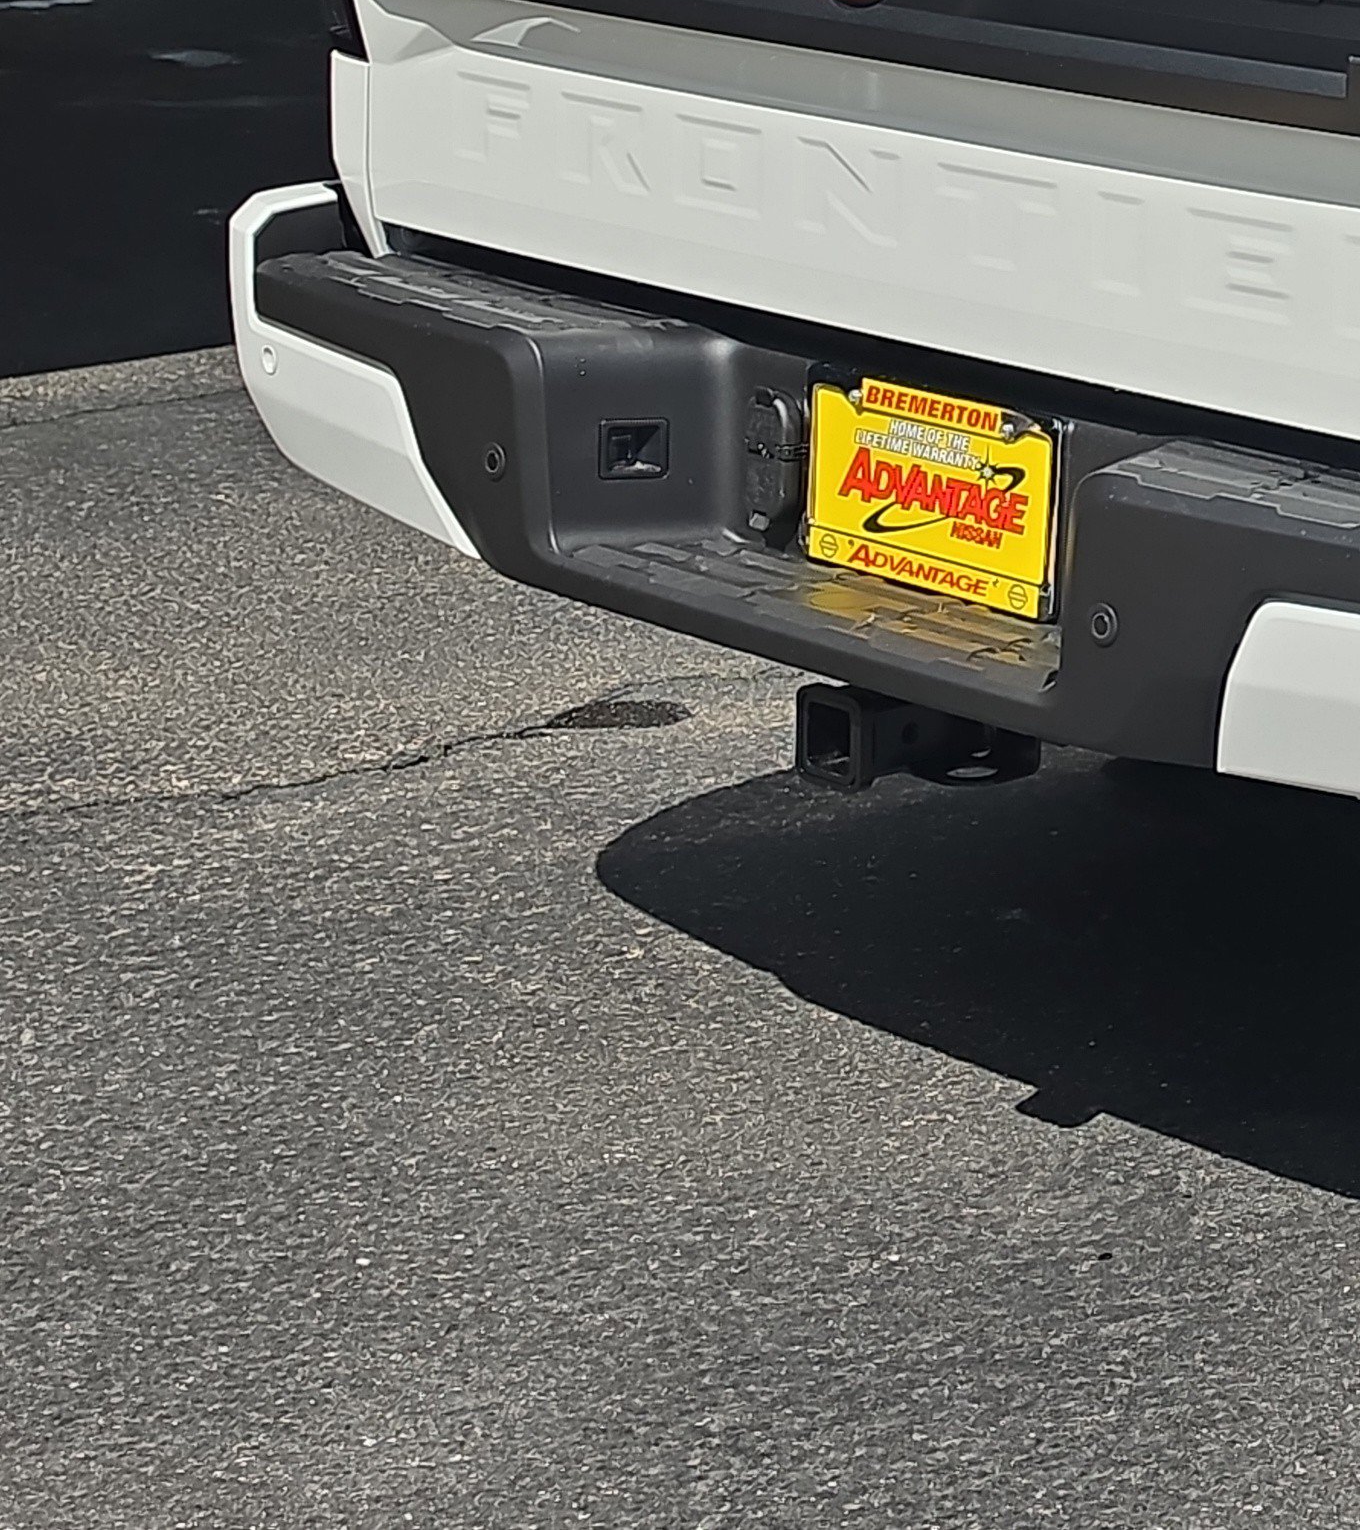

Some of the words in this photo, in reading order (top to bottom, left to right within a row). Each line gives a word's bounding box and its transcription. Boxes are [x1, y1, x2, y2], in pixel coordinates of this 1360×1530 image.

[865, 384, 999, 433] BREMERTON
[855, 427, 910, 456] LIFETIME
[912, 439, 982, 471] WARRANTY
[889, 419, 925, 441] HOME
[926, 426, 944, 444] OF
[946, 432, 970, 452] THE
[838, 446, 1029, 536] ADVANTAGE
[950, 520, 1004, 550] NISSAN
[847, 543, 990, 598] ADVANTAGE
